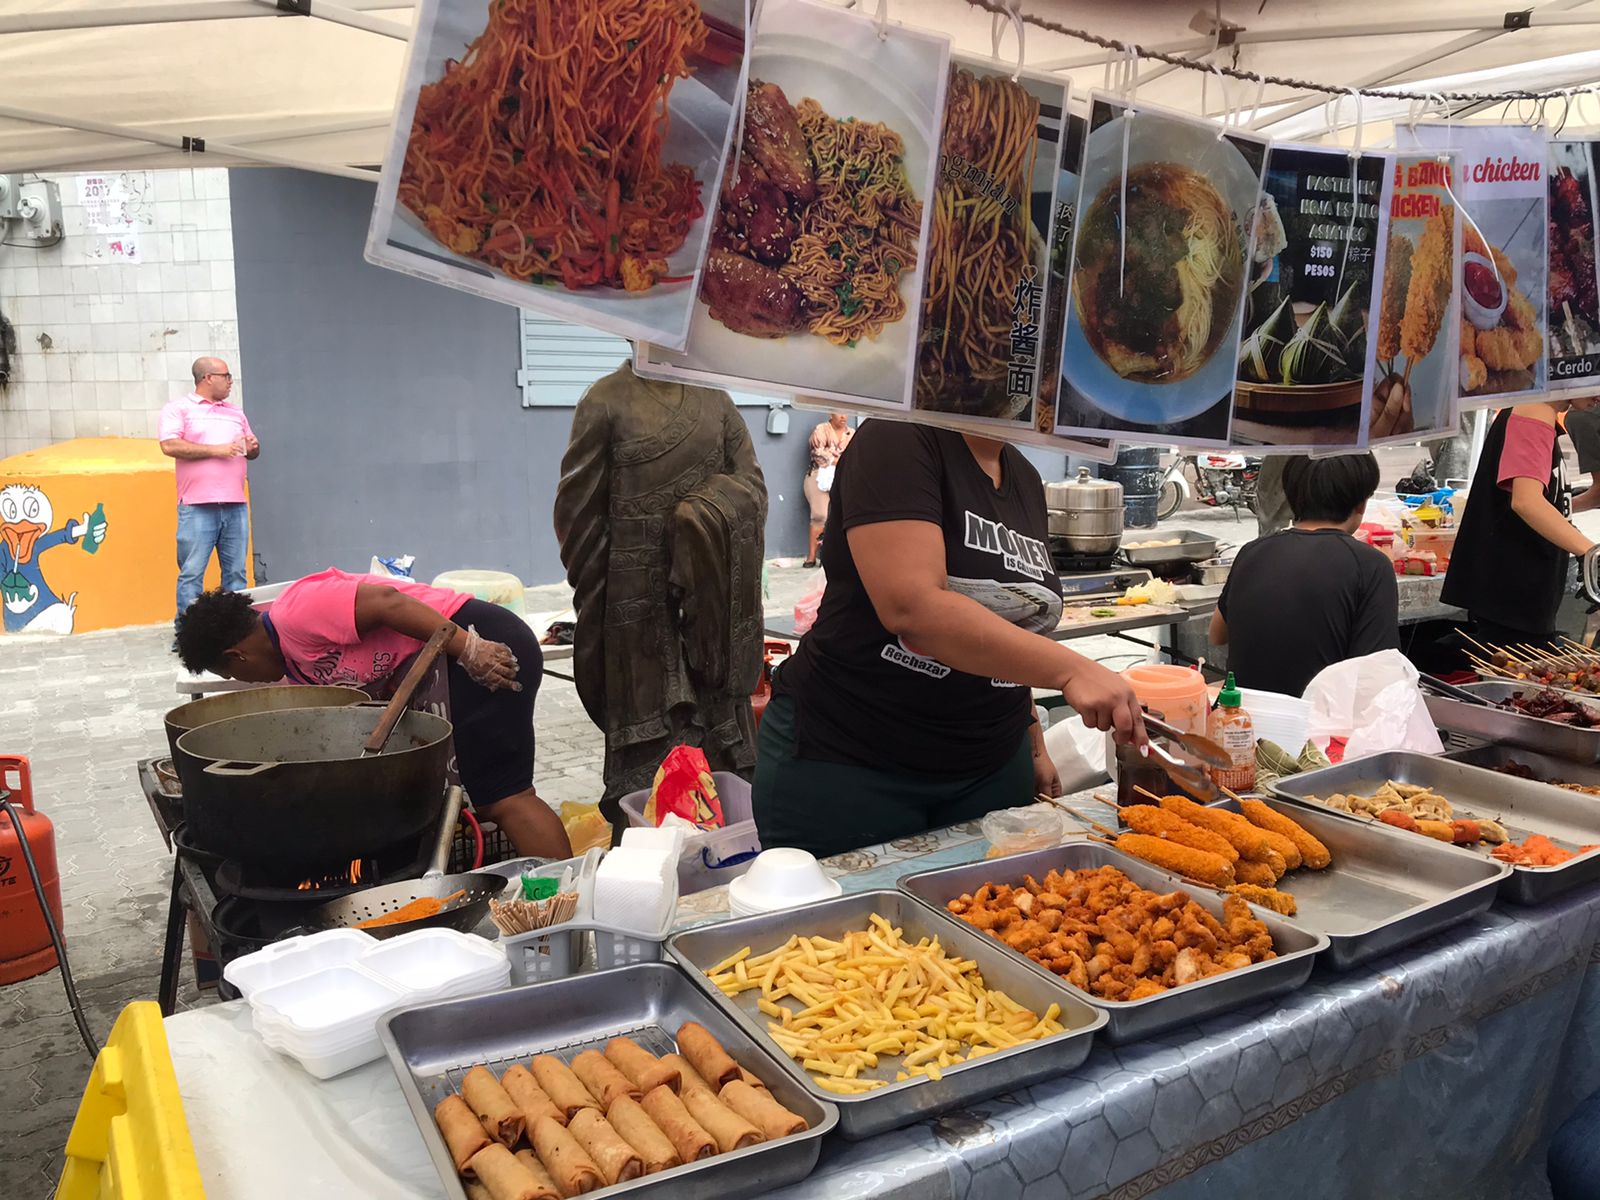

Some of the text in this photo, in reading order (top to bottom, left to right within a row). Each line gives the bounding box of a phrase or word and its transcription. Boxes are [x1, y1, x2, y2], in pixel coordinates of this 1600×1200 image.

[1408, 161, 1452, 190] BANG
[1473, 156, 1540, 183] chicken
[1310, 245, 1333, 259] $150
[1304, 263, 1335, 278] PESOS
[1557, 357, 1593, 376] Cerdo
[964, 510, 1054, 575] MONEY
[1006, 556, 1017, 570] IS
[884, 645, 949, 677] Rechazar
